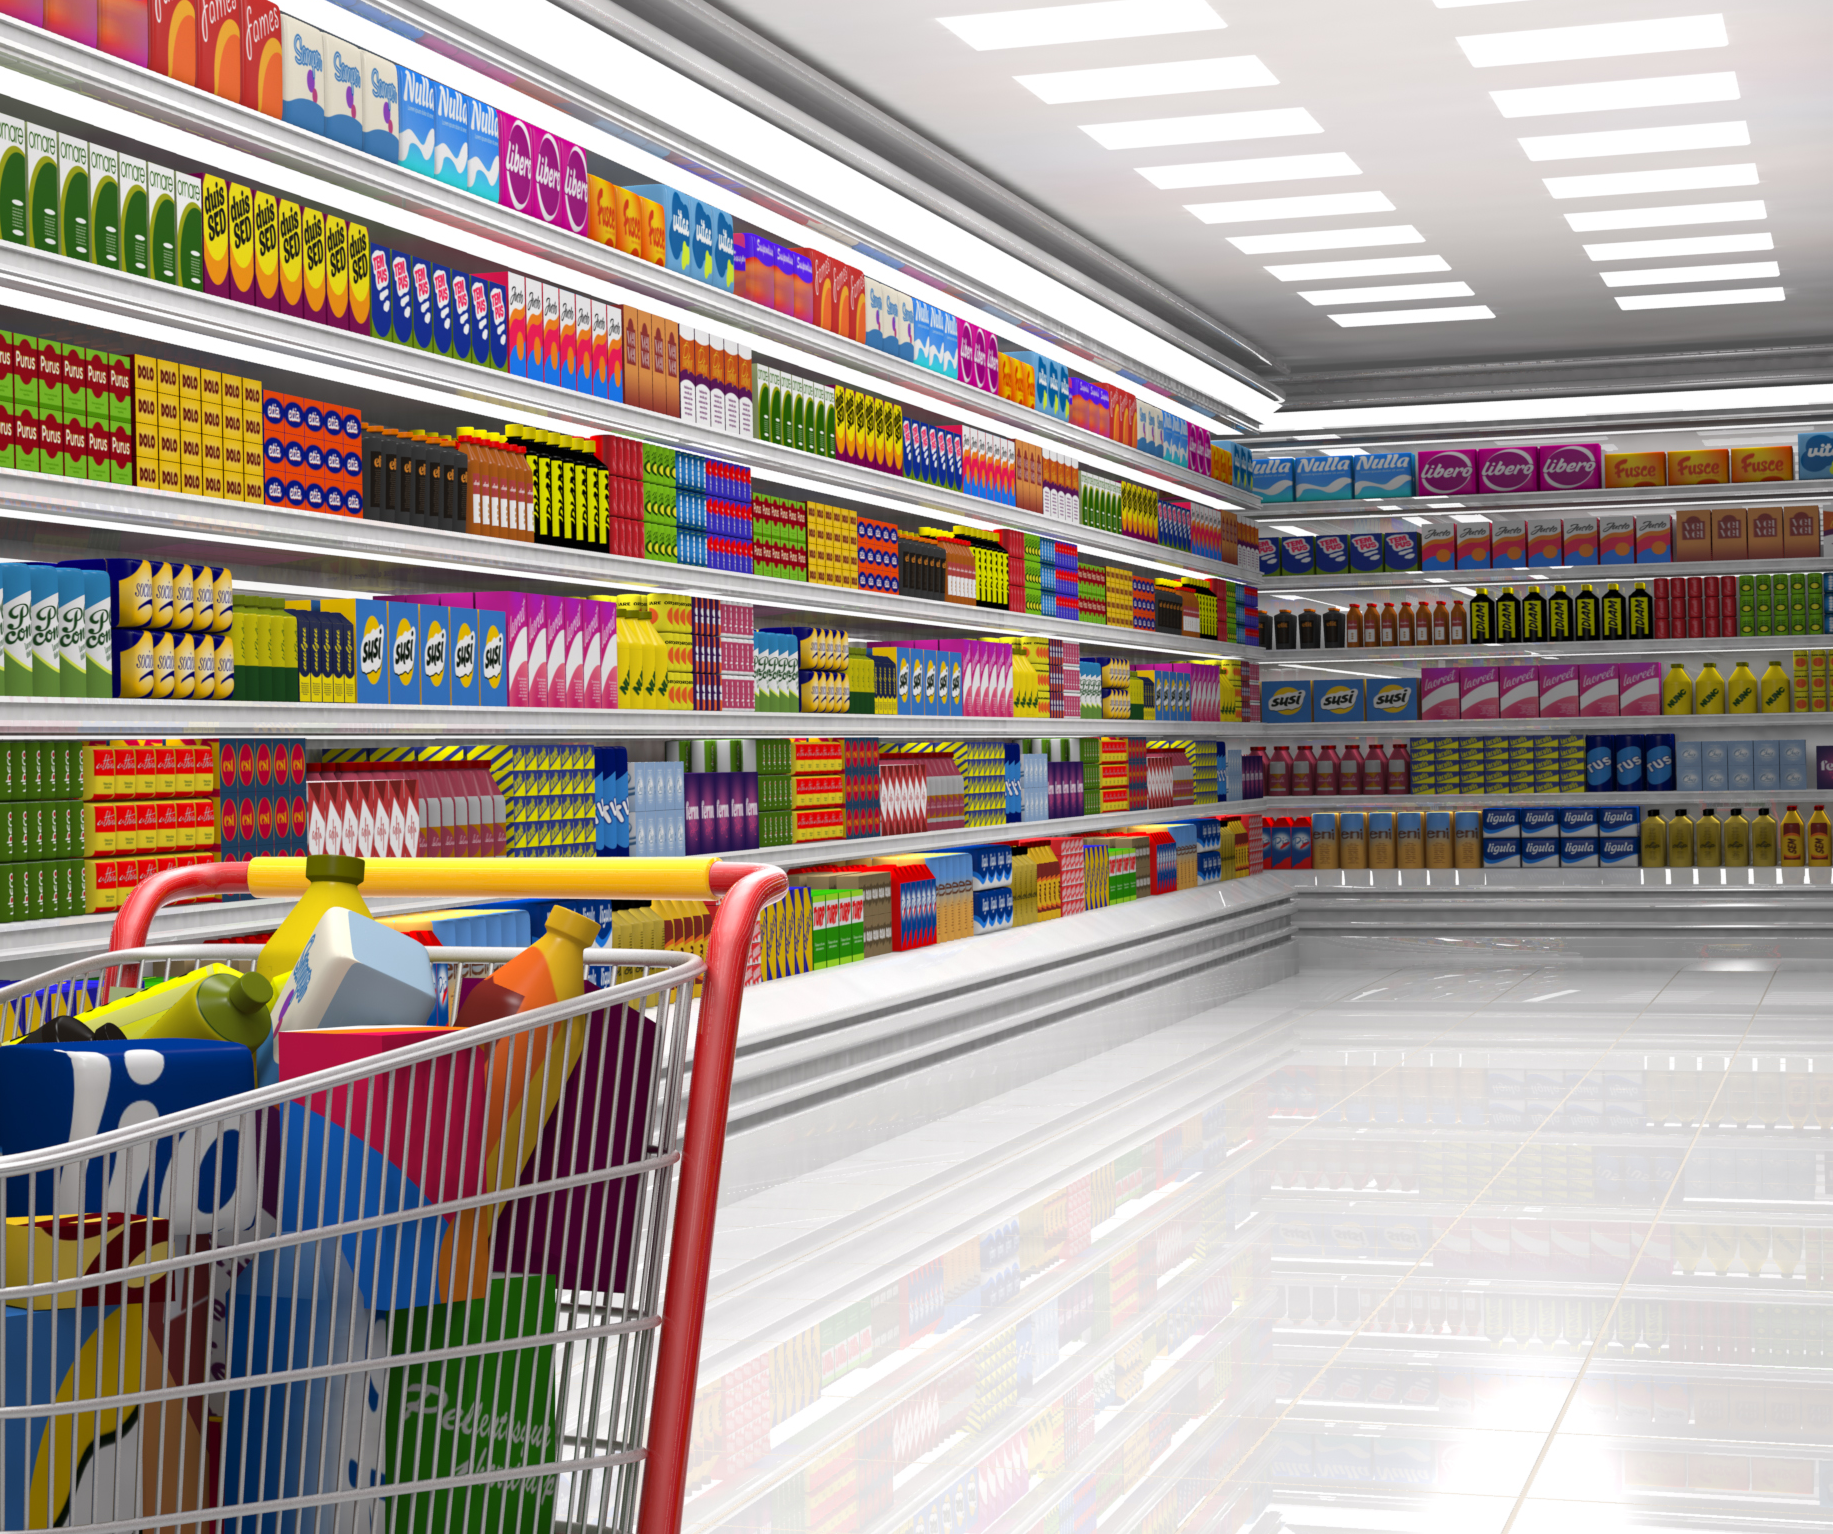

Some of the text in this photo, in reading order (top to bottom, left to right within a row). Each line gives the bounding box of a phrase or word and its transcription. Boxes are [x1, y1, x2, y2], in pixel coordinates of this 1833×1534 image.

[245, 5, 279, 61] fames
[1297, 456, 1350, 473] Nulla
[1421, 461, 1472, 480] libero
[1614, 462, 1656, 479] Fusce
[1425, 528, 1452, 539] Justo
[1424, 669, 1456, 691] laoreet
[1271, 692, 1302, 708] susi
[1486, 813, 1515, 824] ligula
